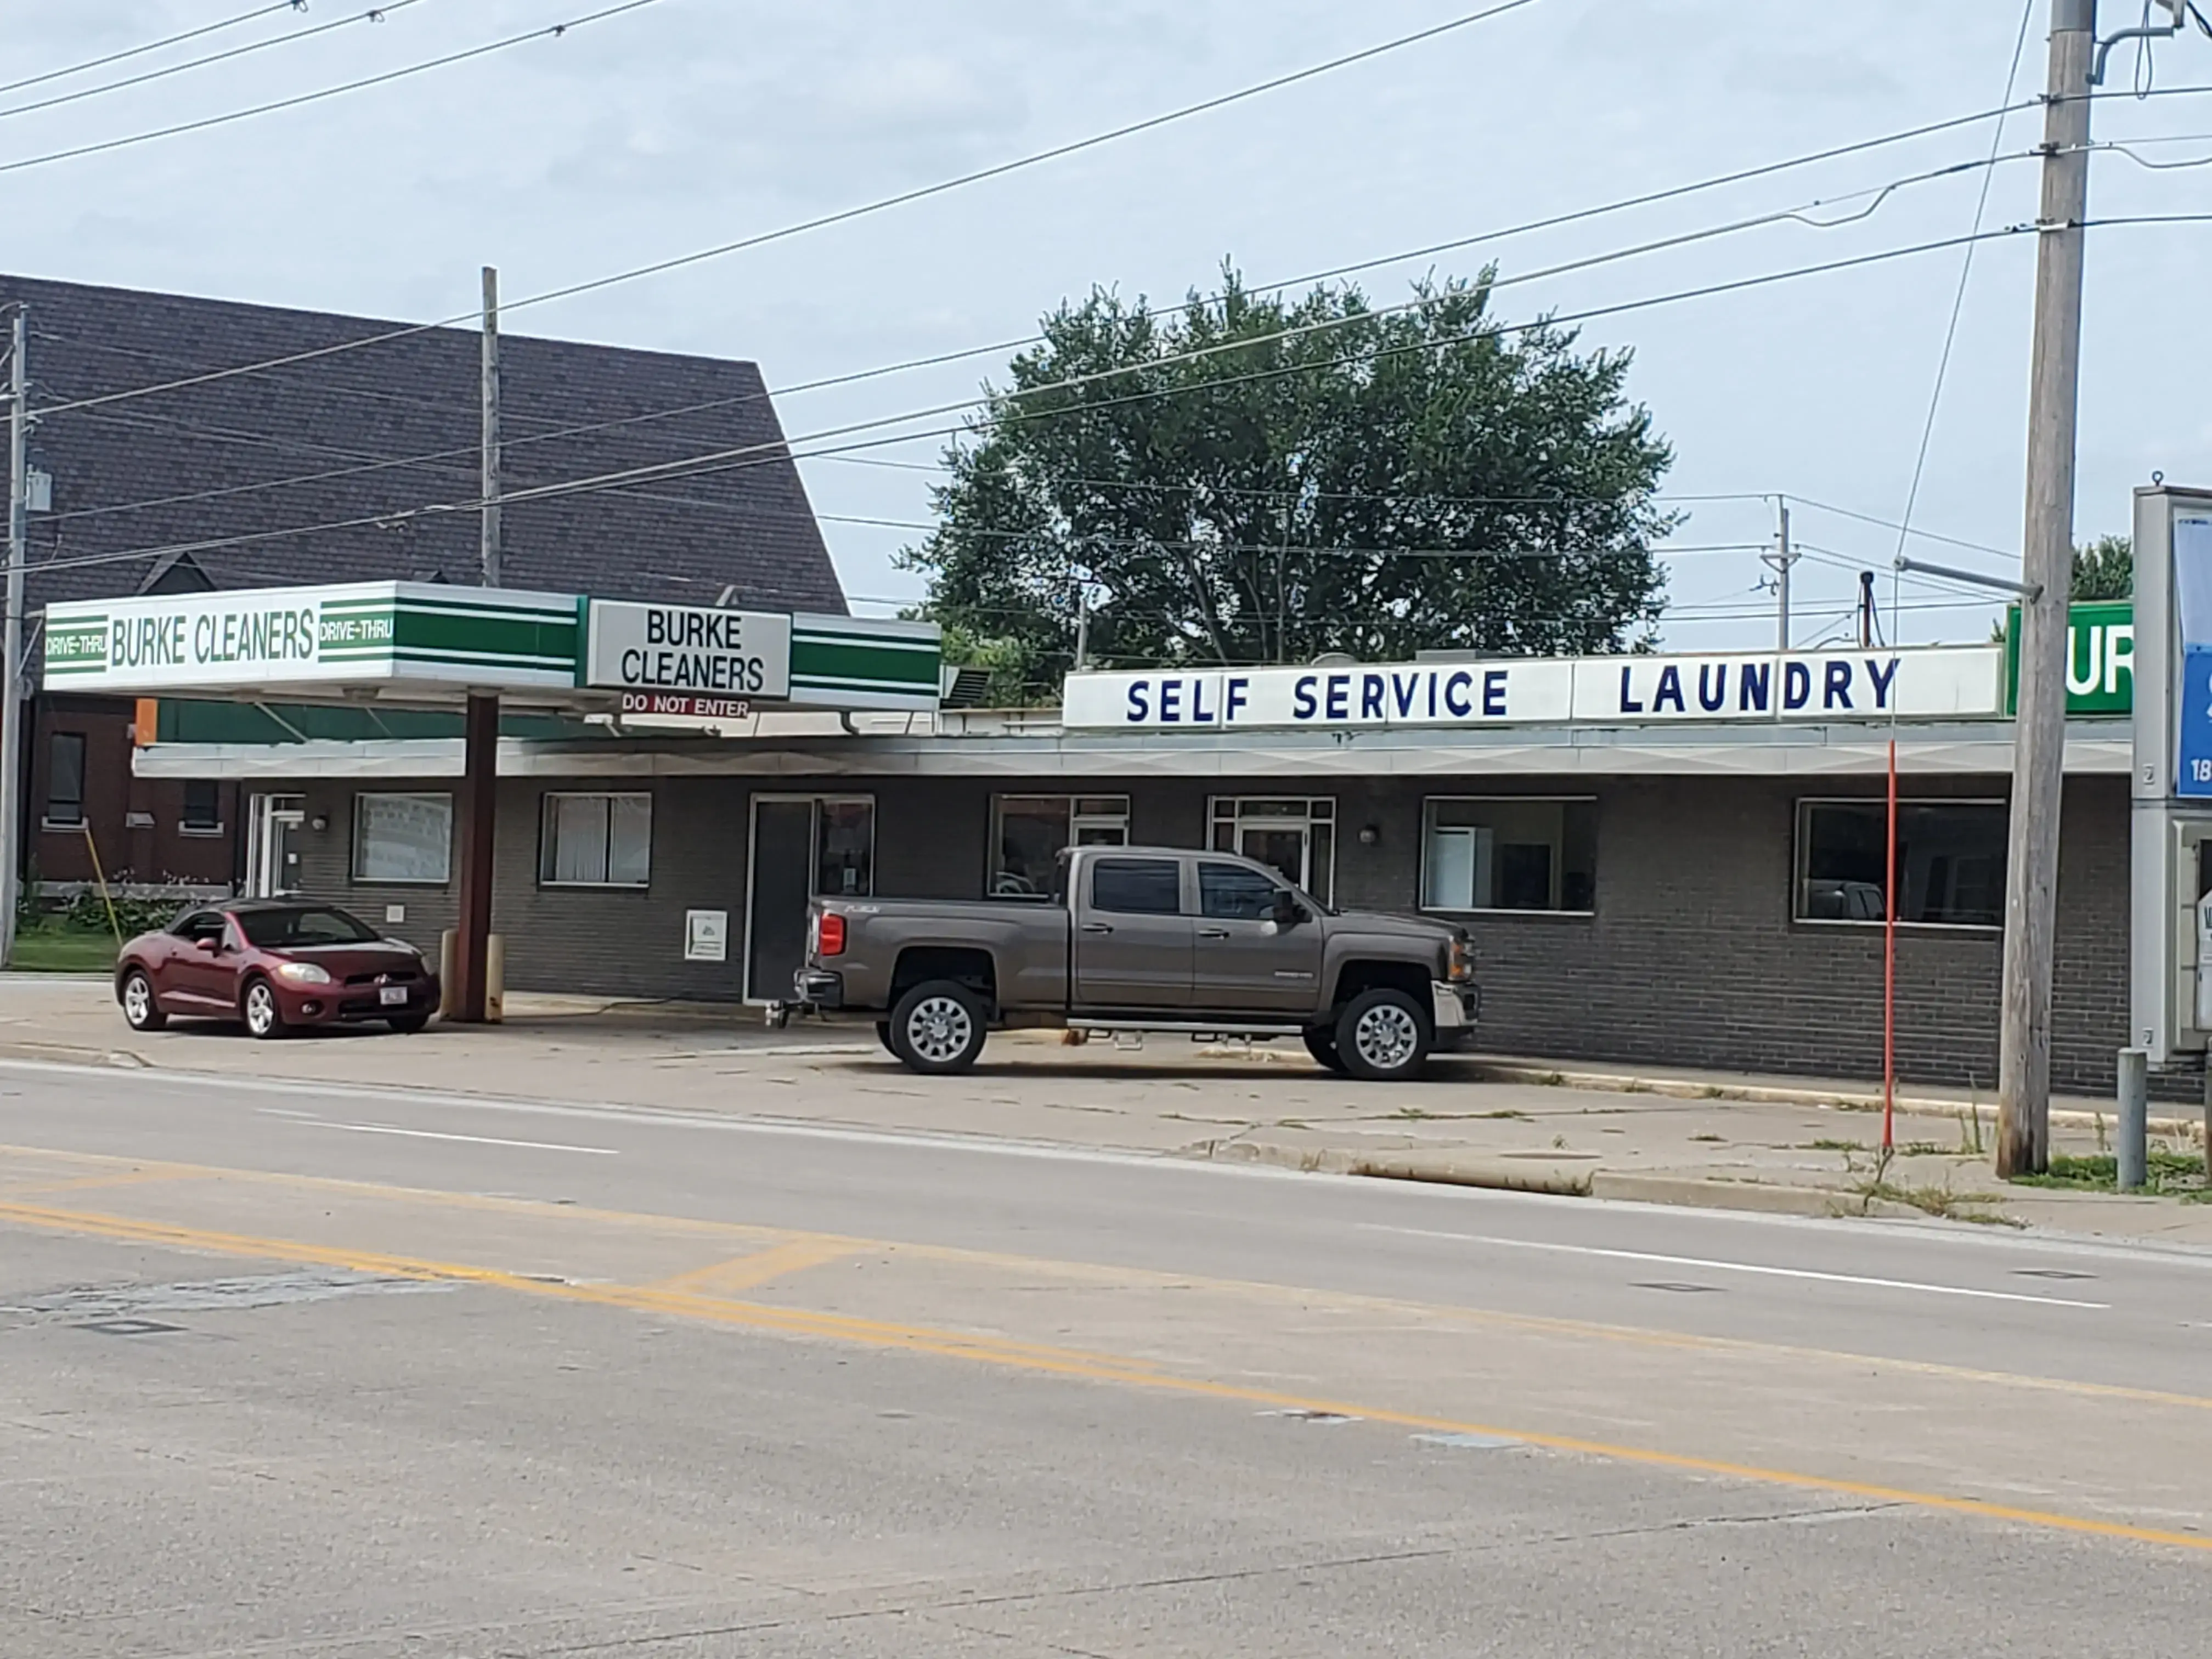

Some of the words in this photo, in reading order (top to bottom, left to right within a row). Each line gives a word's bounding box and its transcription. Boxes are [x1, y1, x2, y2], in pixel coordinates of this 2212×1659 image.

[46, 635, 107, 655] DRIVE-THRU
[112, 616, 187, 667] BURKE
[195, 608, 313, 664] CLEANERS
[320, 617, 393, 641] DRIVE-THRU
[648, 610, 741, 648] BURKE
[622, 649, 764, 692] CLEANERS
[2066, 625, 2133, 695] UR
[623, 693, 648, 710] DO
[654, 696, 690, 713] NOT
[695, 698, 748, 716] ENTER
[1127, 679, 1249, 721] SELF
[1293, 670, 1509, 720] SERVICE
[1620, 658, 1901, 713] LAUNDRY
